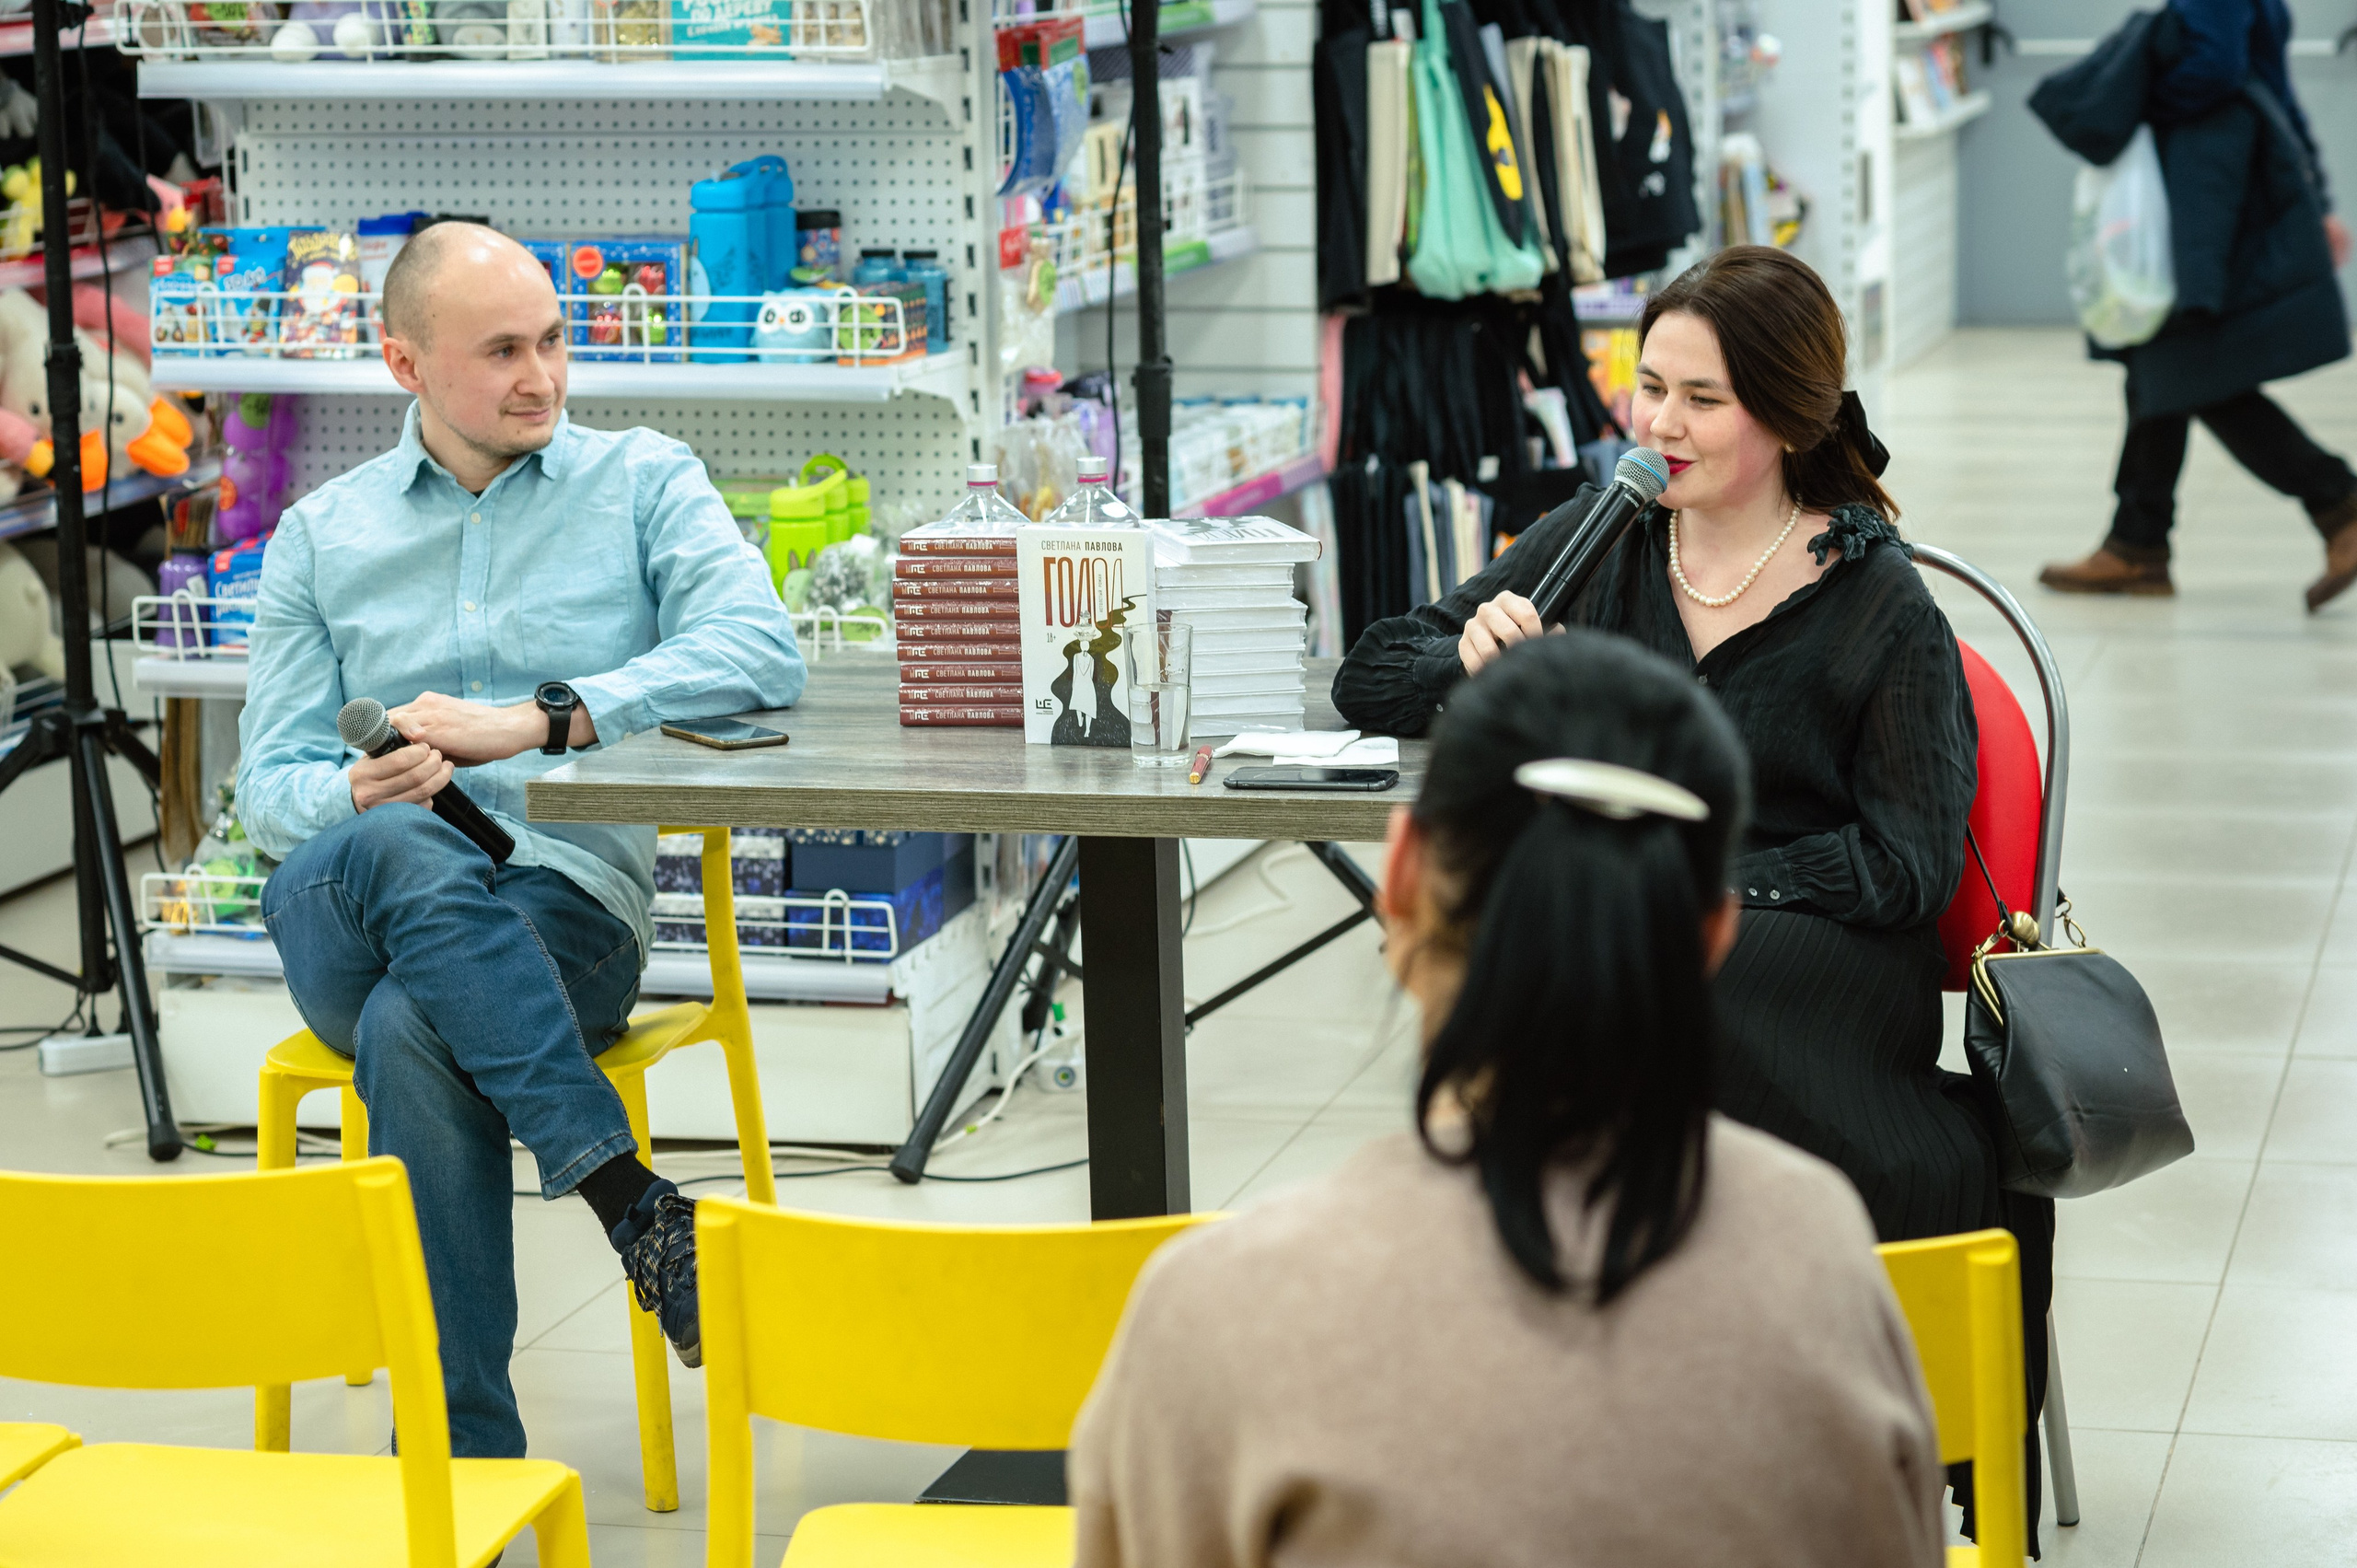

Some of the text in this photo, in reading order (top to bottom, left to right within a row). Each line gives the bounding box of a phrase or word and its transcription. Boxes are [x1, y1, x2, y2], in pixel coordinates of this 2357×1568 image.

[1040, 540, 1123, 552] СВЕТЛАНА ПАВЛОВА
[932, 564, 962, 573] СВЕТЛАНА
[963, 564, 992, 573] ПАВЛОВА
[1043, 556, 1125, 628] ГОЛОД
[930, 606, 960, 614] СВЕТЛАНА
[961, 606, 990, 614] ПАВЛОВА
[1046, 633, 1056, 644] 18+
[933, 647, 963, 656] СВЕТЛАНА
[964, 647, 993, 656] ПАВЛОВА
[935, 691, 964, 699] СВЕТЛАНА
[966, 691, 994, 699] ПАВЛОВА
